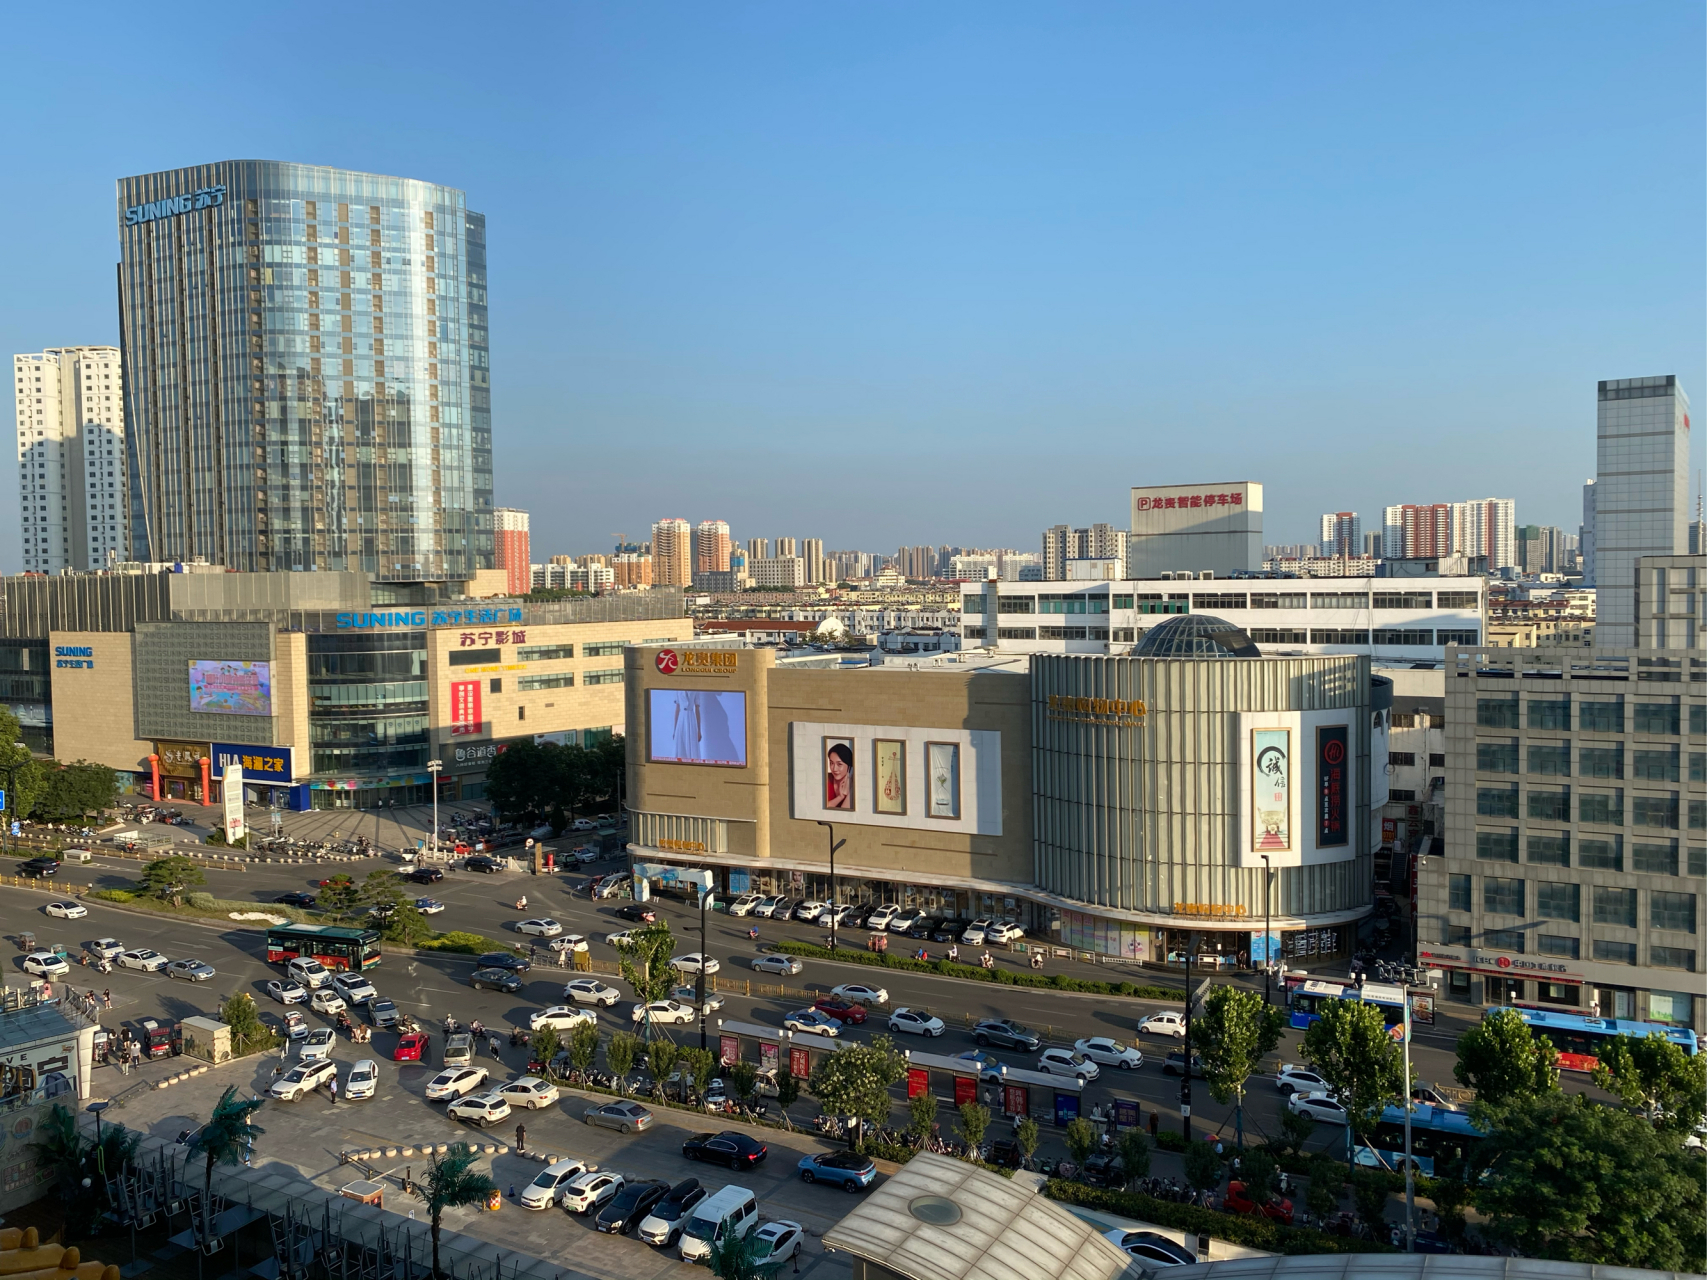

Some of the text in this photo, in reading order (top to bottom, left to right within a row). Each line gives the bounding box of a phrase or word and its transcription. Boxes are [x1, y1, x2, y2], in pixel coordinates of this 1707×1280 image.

[126, 184, 227, 227] SUNING 苏宁
[1151, 492, 1243, 510] 龙贵智能停车场
[336, 607, 523, 629] SUNING 苏宁生活广场
[460, 630, 527, 647] 苏宁影城
[55, 646, 93, 657] SUNING
[455, 745, 497, 761] 鲁谷道香
[242, 755, 284, 772] 海澜之家
